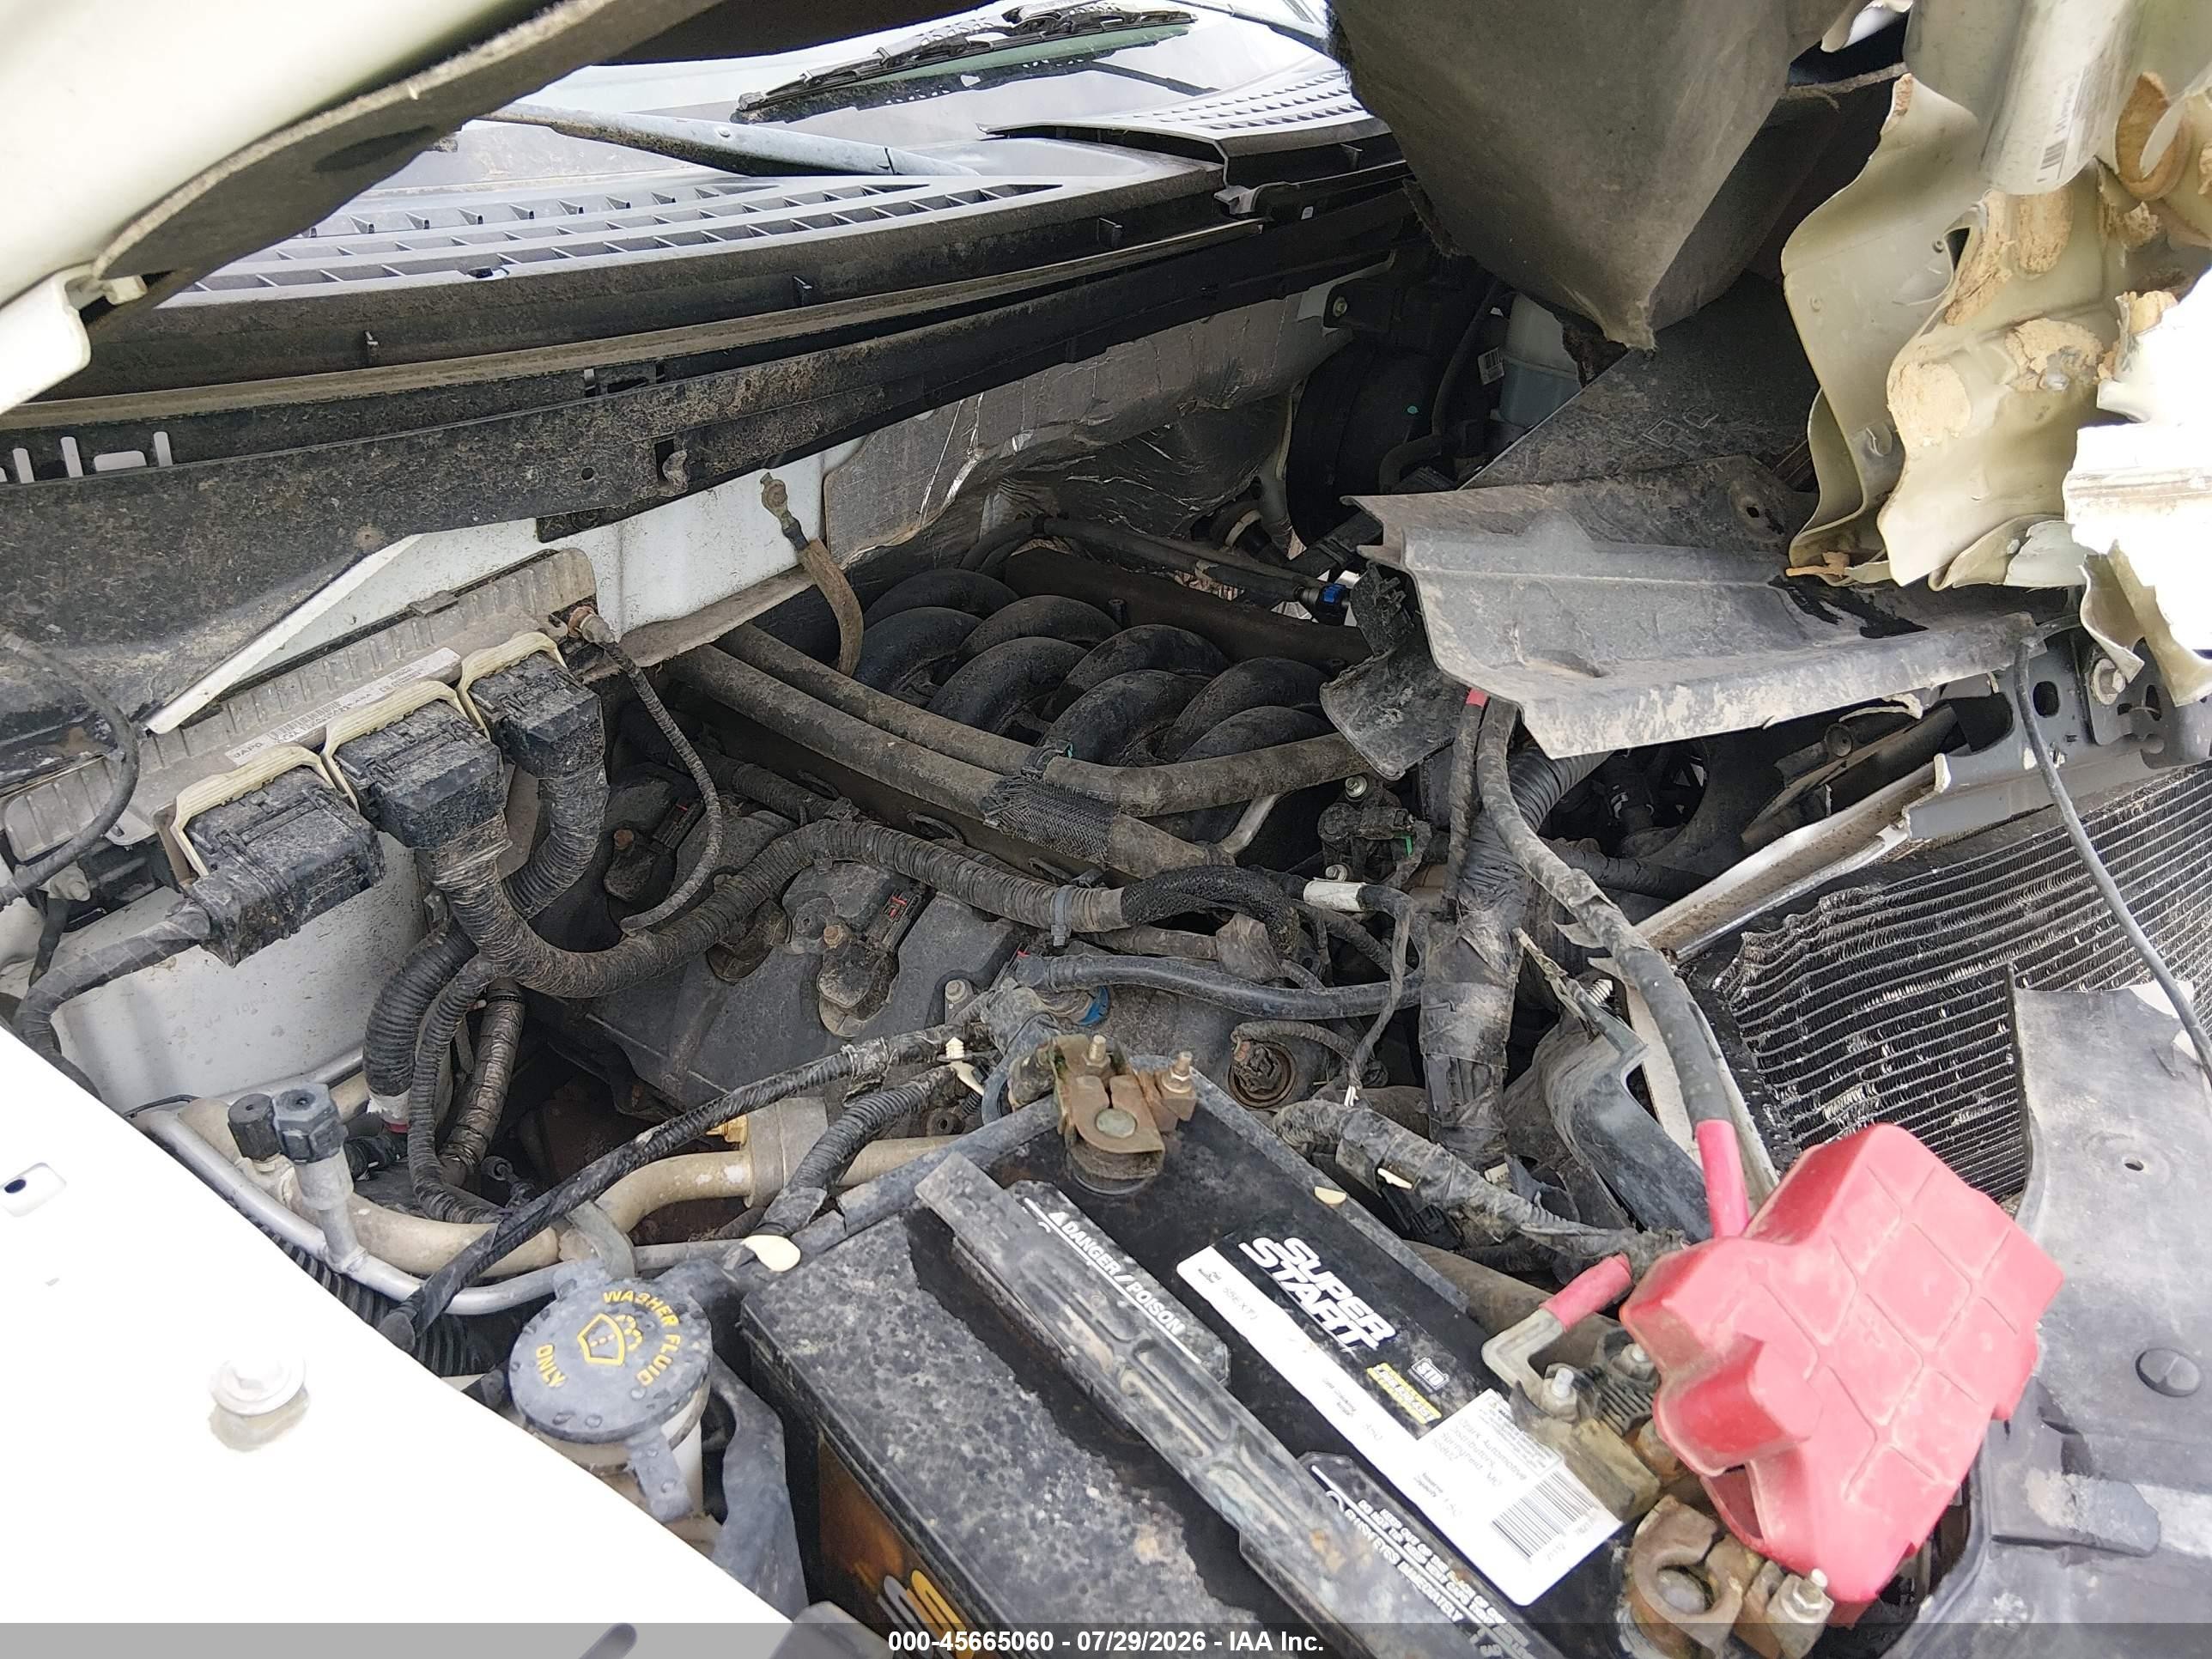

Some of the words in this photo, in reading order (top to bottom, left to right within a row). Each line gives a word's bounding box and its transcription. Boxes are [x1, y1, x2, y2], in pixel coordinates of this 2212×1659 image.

[603, 1290, 680, 1327] WASHER
[1238, 1237, 1378, 1350] START
[1284, 1237, 1395, 1340] SUPER
[536, 1344, 567, 1388] ONLY
[636, 1334, 681, 1387] FLUID
